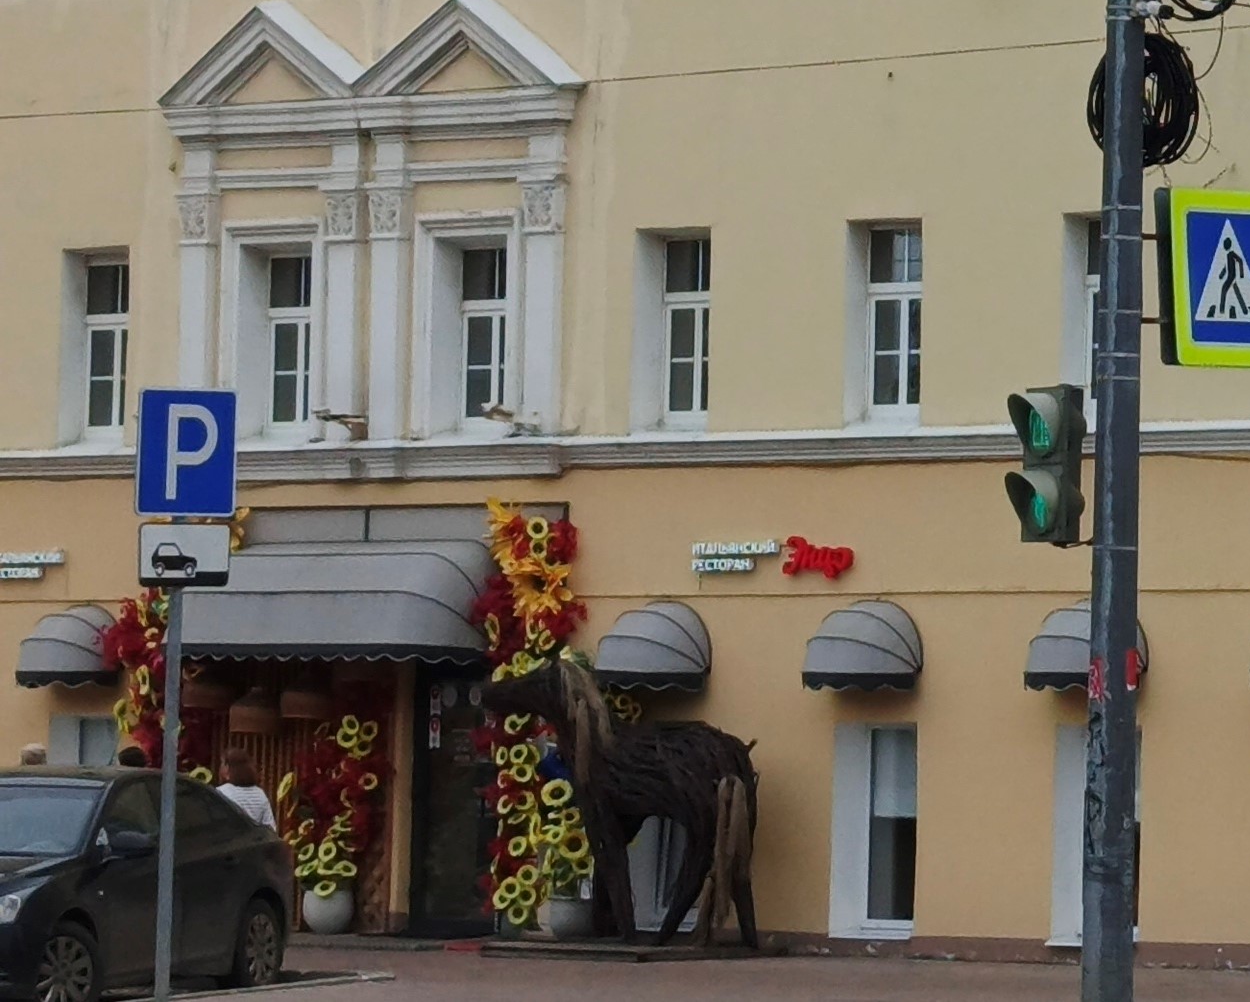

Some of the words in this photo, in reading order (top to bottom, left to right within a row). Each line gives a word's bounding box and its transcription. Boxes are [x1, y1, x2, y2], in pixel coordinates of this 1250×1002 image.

[165, 403, 219, 500] P
[691, 539, 778, 555] ИТАЛЬЯНСКИЙ
[691, 558, 753, 572] РЕСТОРАН
